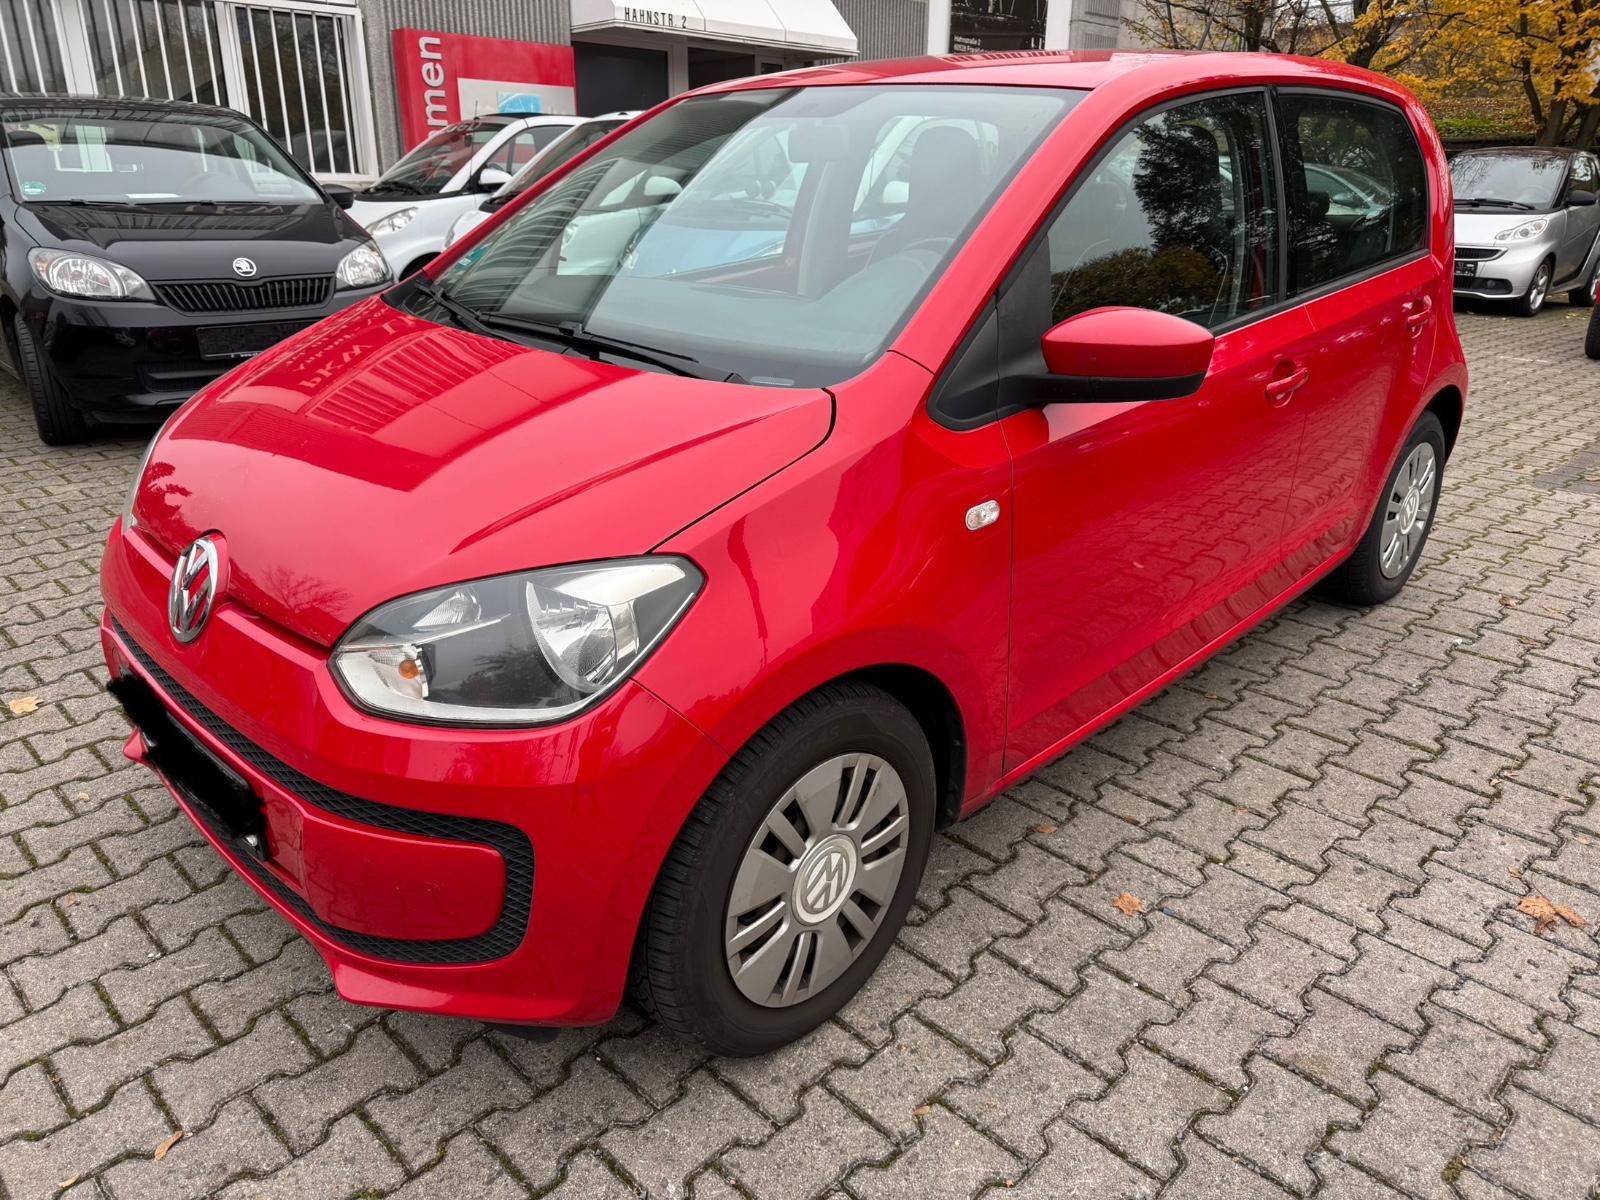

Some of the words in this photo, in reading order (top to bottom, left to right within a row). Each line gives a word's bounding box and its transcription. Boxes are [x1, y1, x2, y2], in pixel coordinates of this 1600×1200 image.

[624, 7, 678, 28] HAHNSTR.
[681, 15, 687, 29] 2
[418, 36, 449, 140] men
